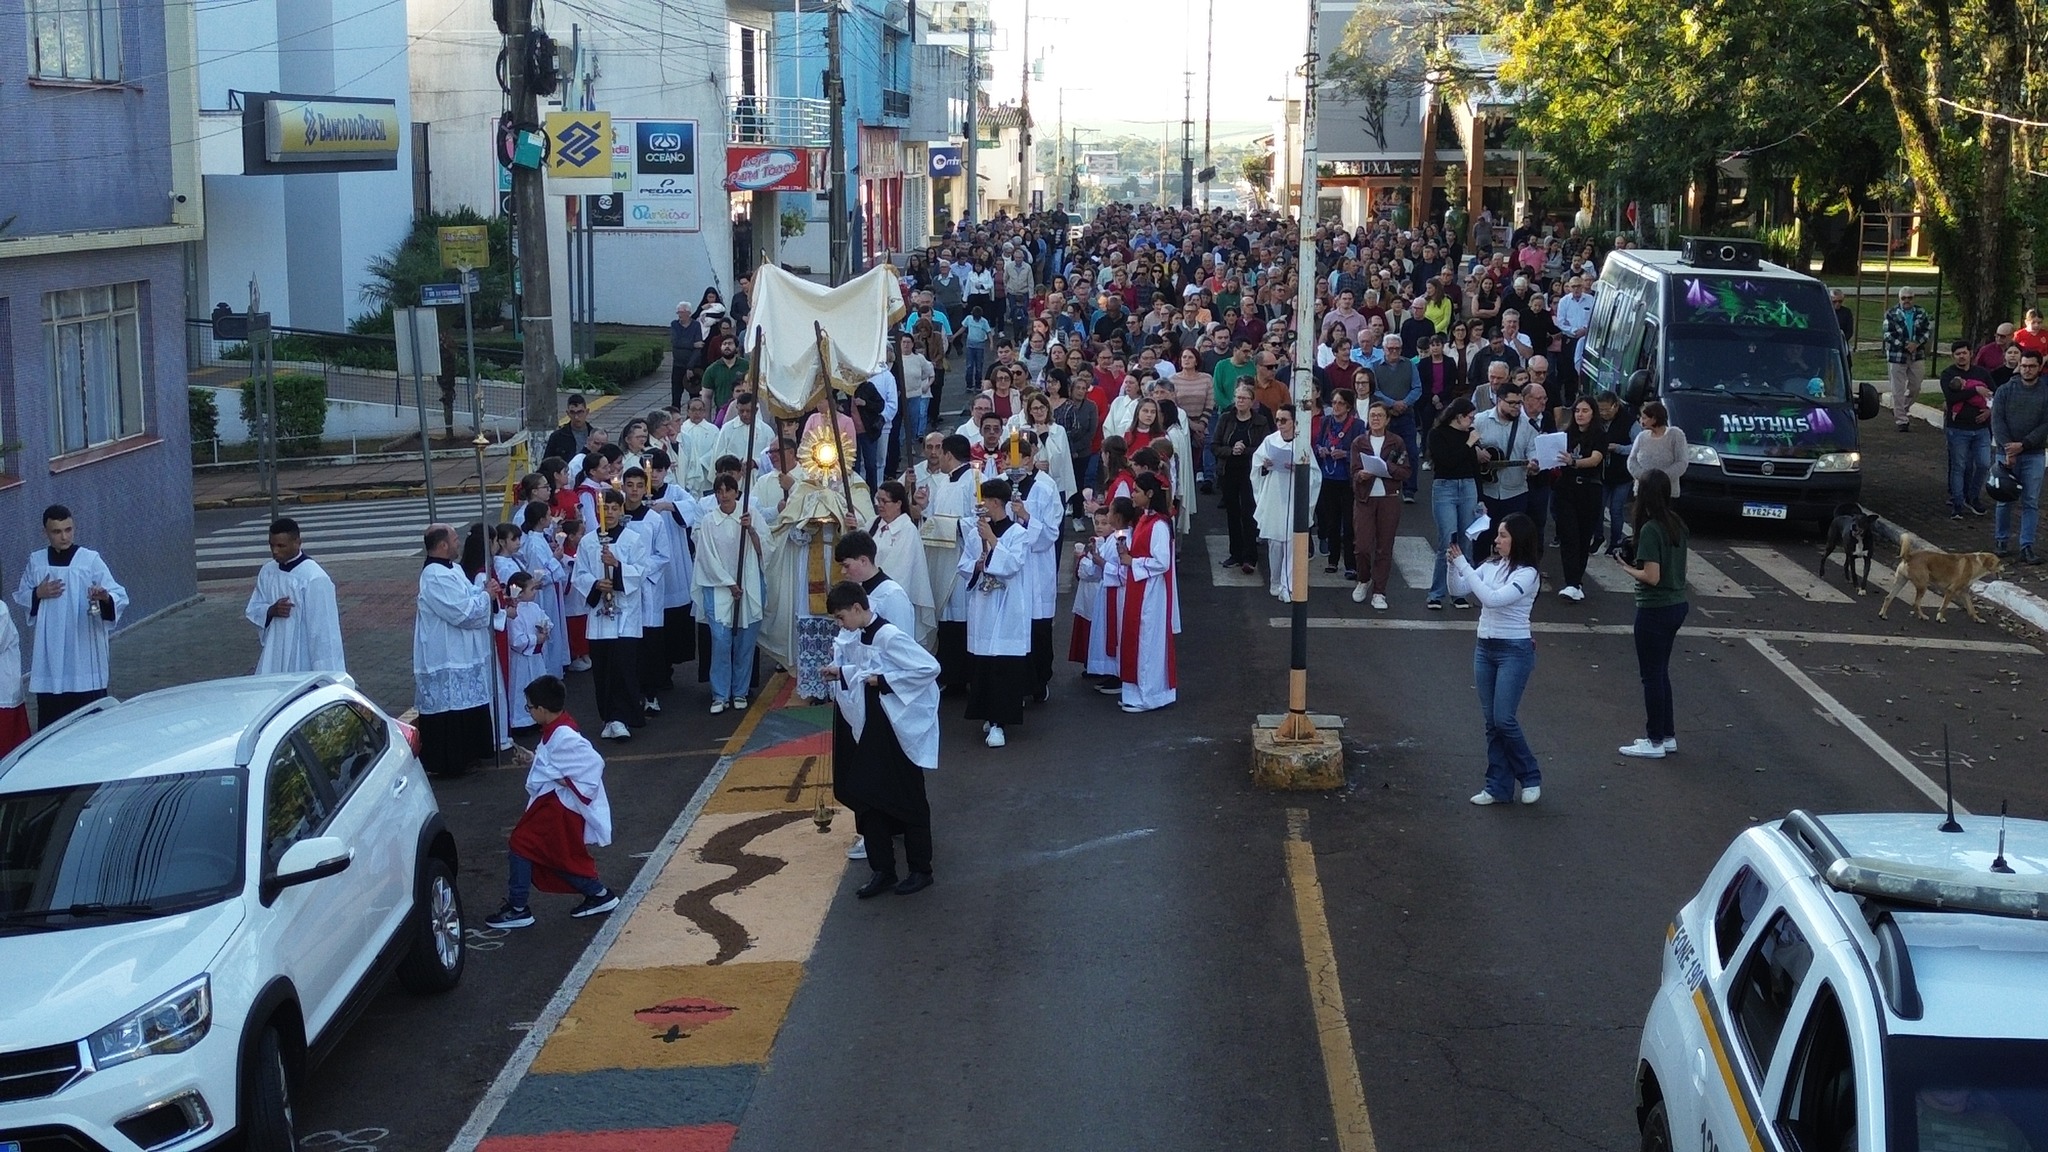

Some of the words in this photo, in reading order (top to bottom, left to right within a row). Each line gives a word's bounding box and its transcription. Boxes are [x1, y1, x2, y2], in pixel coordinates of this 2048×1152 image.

[645, 151, 686, 164] OCEANO
[1671, 926, 1696, 971] FONE
[1684, 957, 1704, 992] 190
[1700, 1117, 1720, 1152] 12
